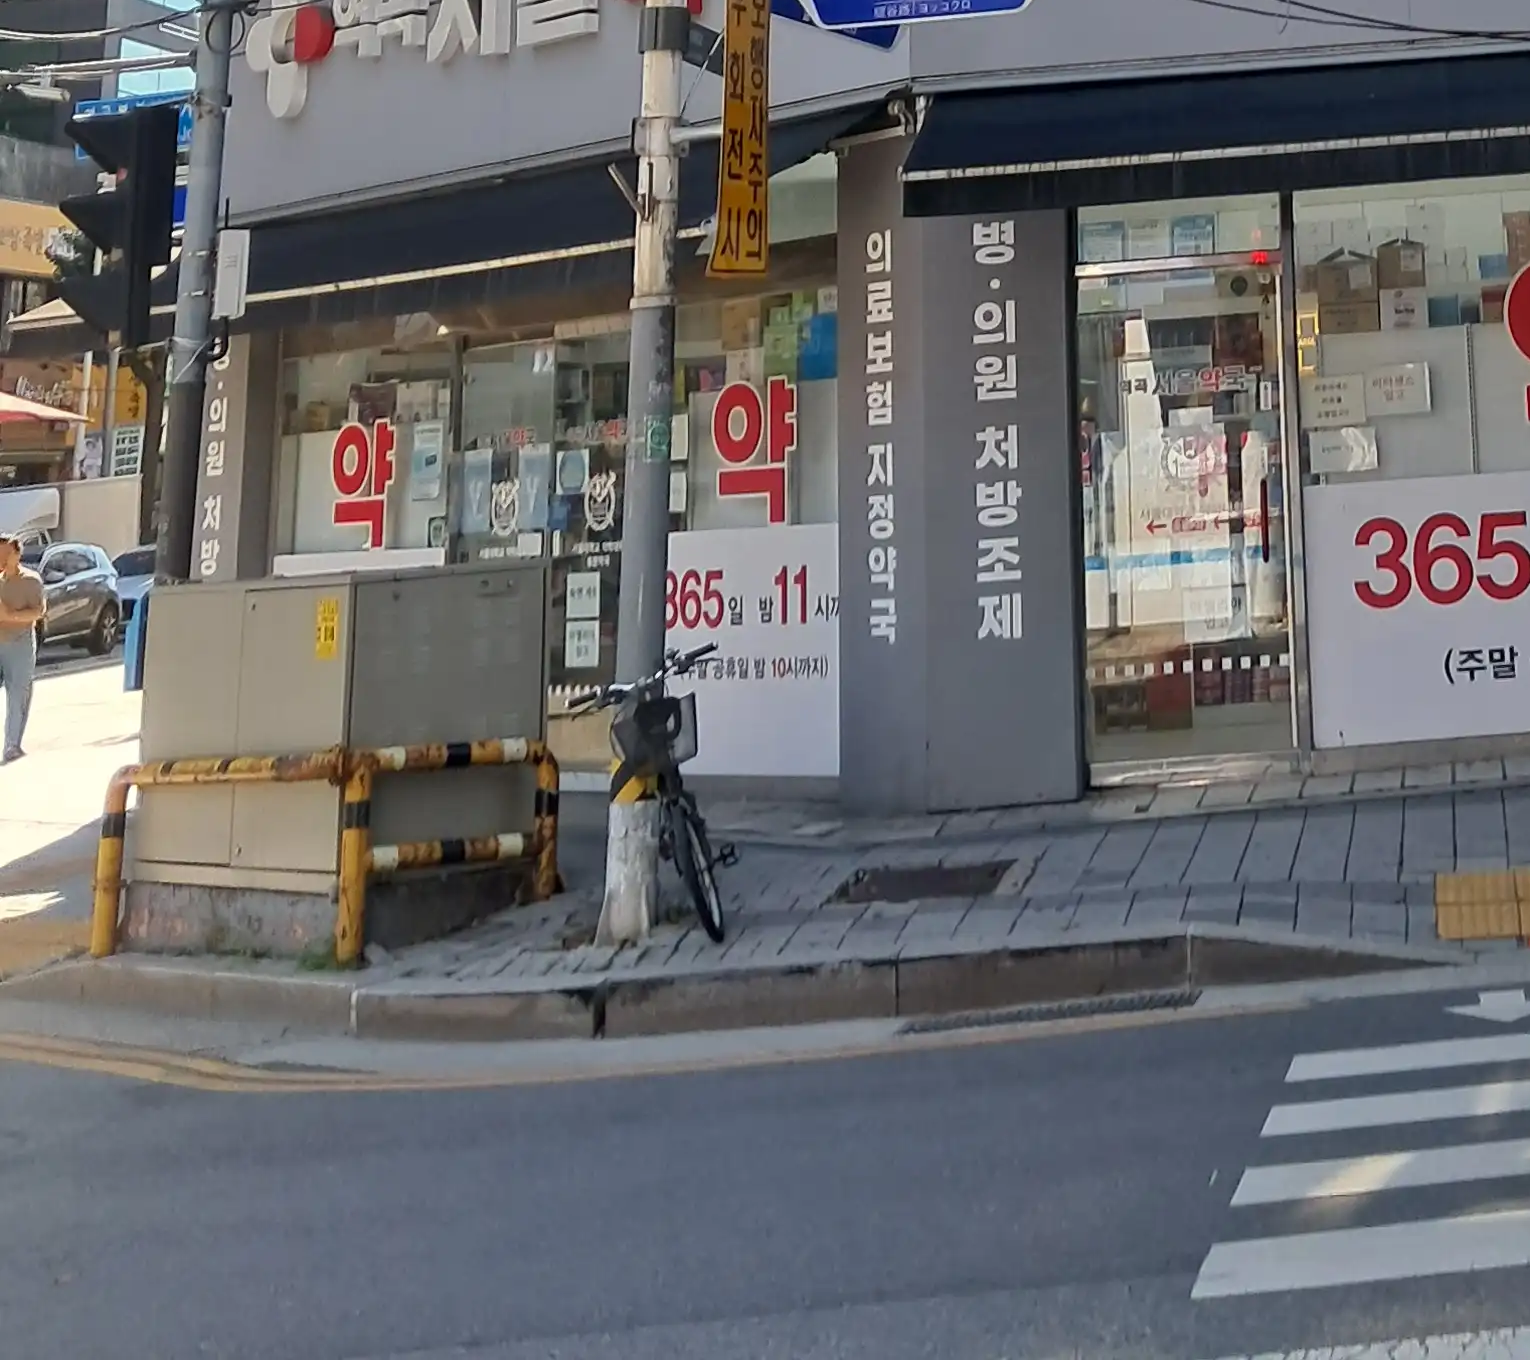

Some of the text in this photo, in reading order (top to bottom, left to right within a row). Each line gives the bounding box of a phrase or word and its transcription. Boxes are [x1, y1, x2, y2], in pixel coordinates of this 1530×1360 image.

[331, 417, 397, 550] 약
[711, 375, 798, 525] 약
[864, 229, 898, 646] 의료보험 지정약국
[973, 423, 1025, 642] 처방조제
